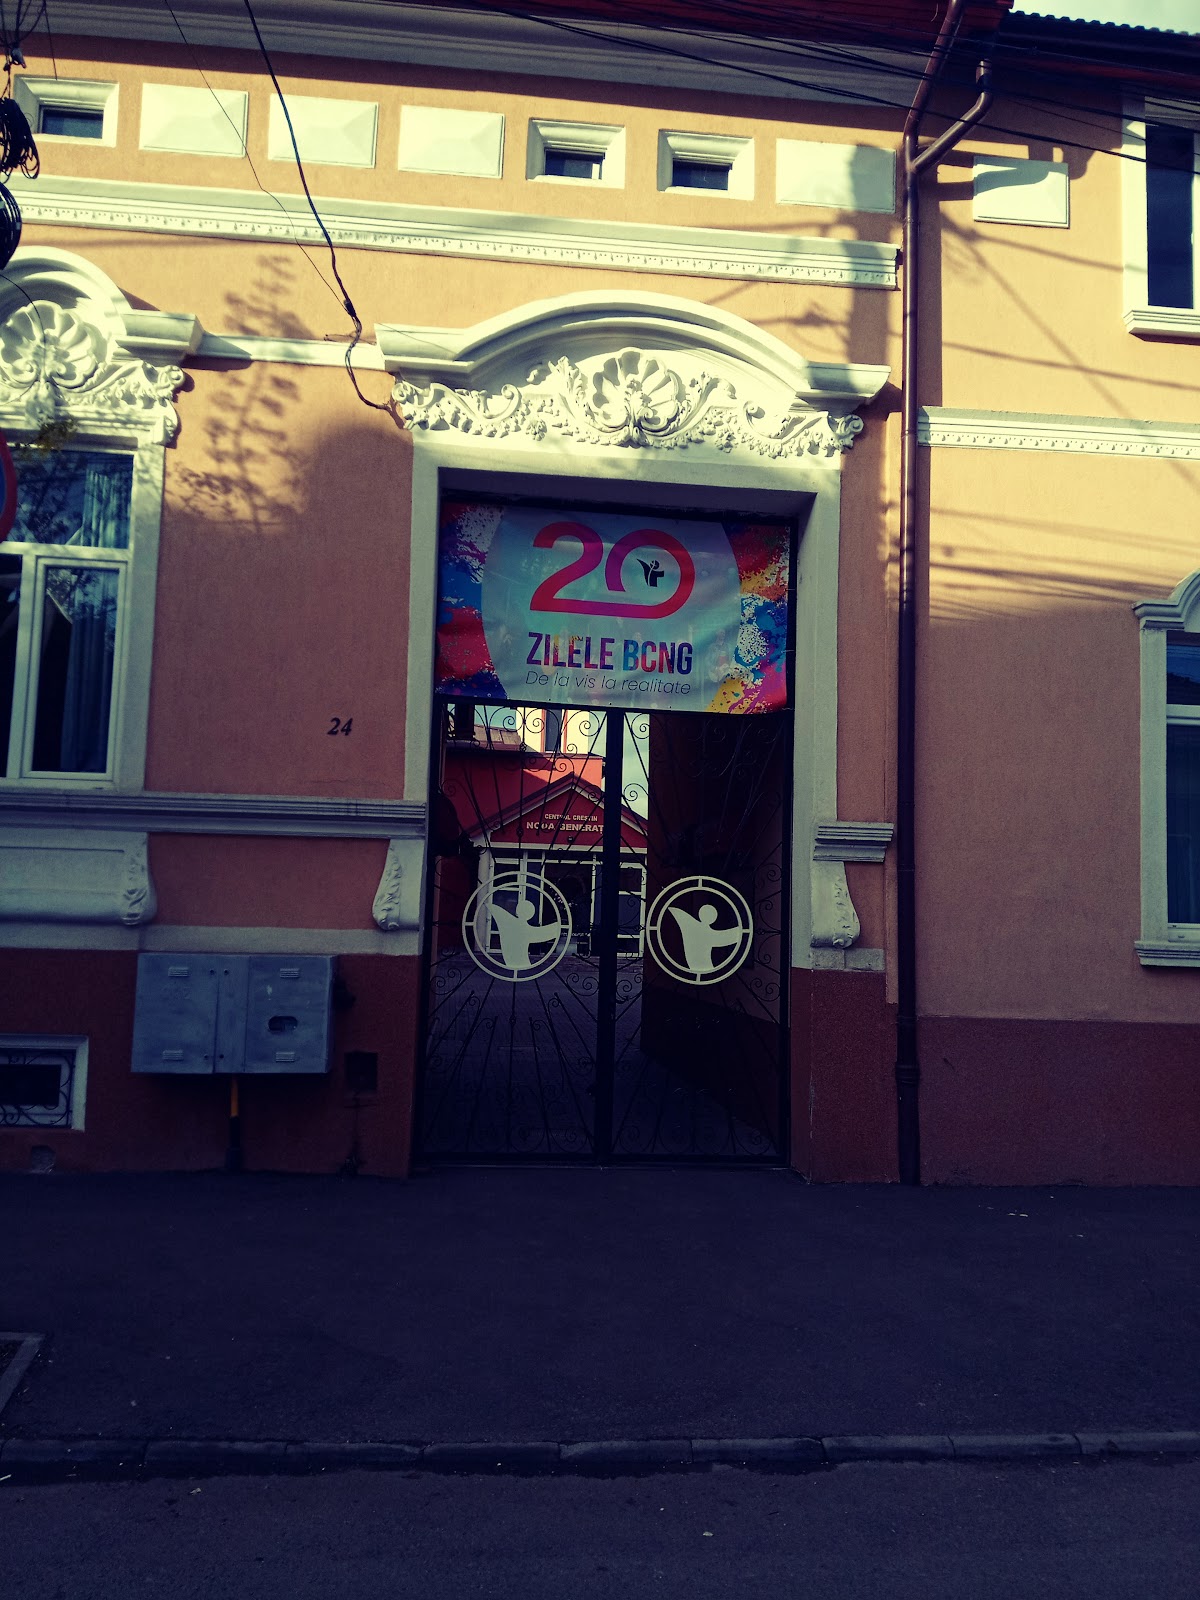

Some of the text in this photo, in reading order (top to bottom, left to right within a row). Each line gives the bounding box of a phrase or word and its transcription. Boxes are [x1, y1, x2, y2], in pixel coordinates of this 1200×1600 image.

[530, 521, 696, 619] 20
[526, 632, 693, 675] ZILELE BCNG
[525, 671, 691, 695] De la vis la realitate
[327, 717, 353, 736] 24
